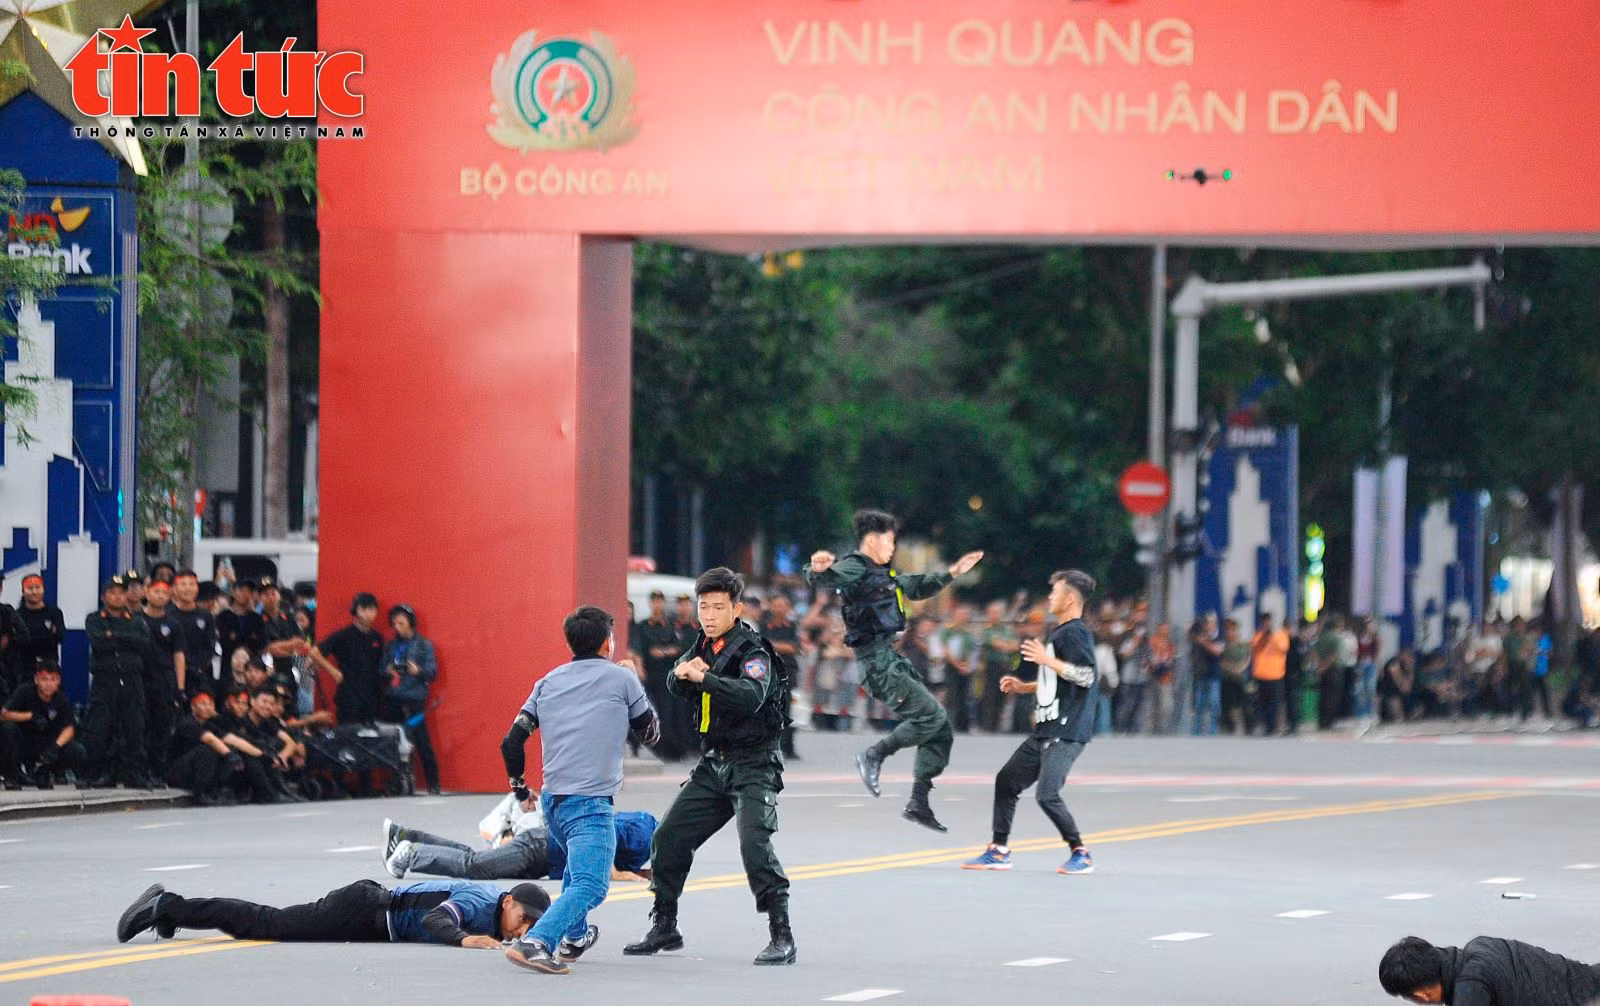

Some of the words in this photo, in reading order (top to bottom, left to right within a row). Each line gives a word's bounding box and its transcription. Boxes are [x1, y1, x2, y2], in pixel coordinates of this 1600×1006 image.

[763, 19, 922, 66] VINH
[949, 18, 1194, 67] QUANG
[763, 84, 942, 133] CÔNG
[963, 93, 1049, 133] AN
[1069, 81, 1246, 134] NHÂN
[1267, 80, 1398, 134] DÂN
[459, 161, 508, 201] BỘ
[514, 163, 614, 197] CÔNG
[620, 169, 669, 196] AN
[905, 152, 1046, 193] NAM
